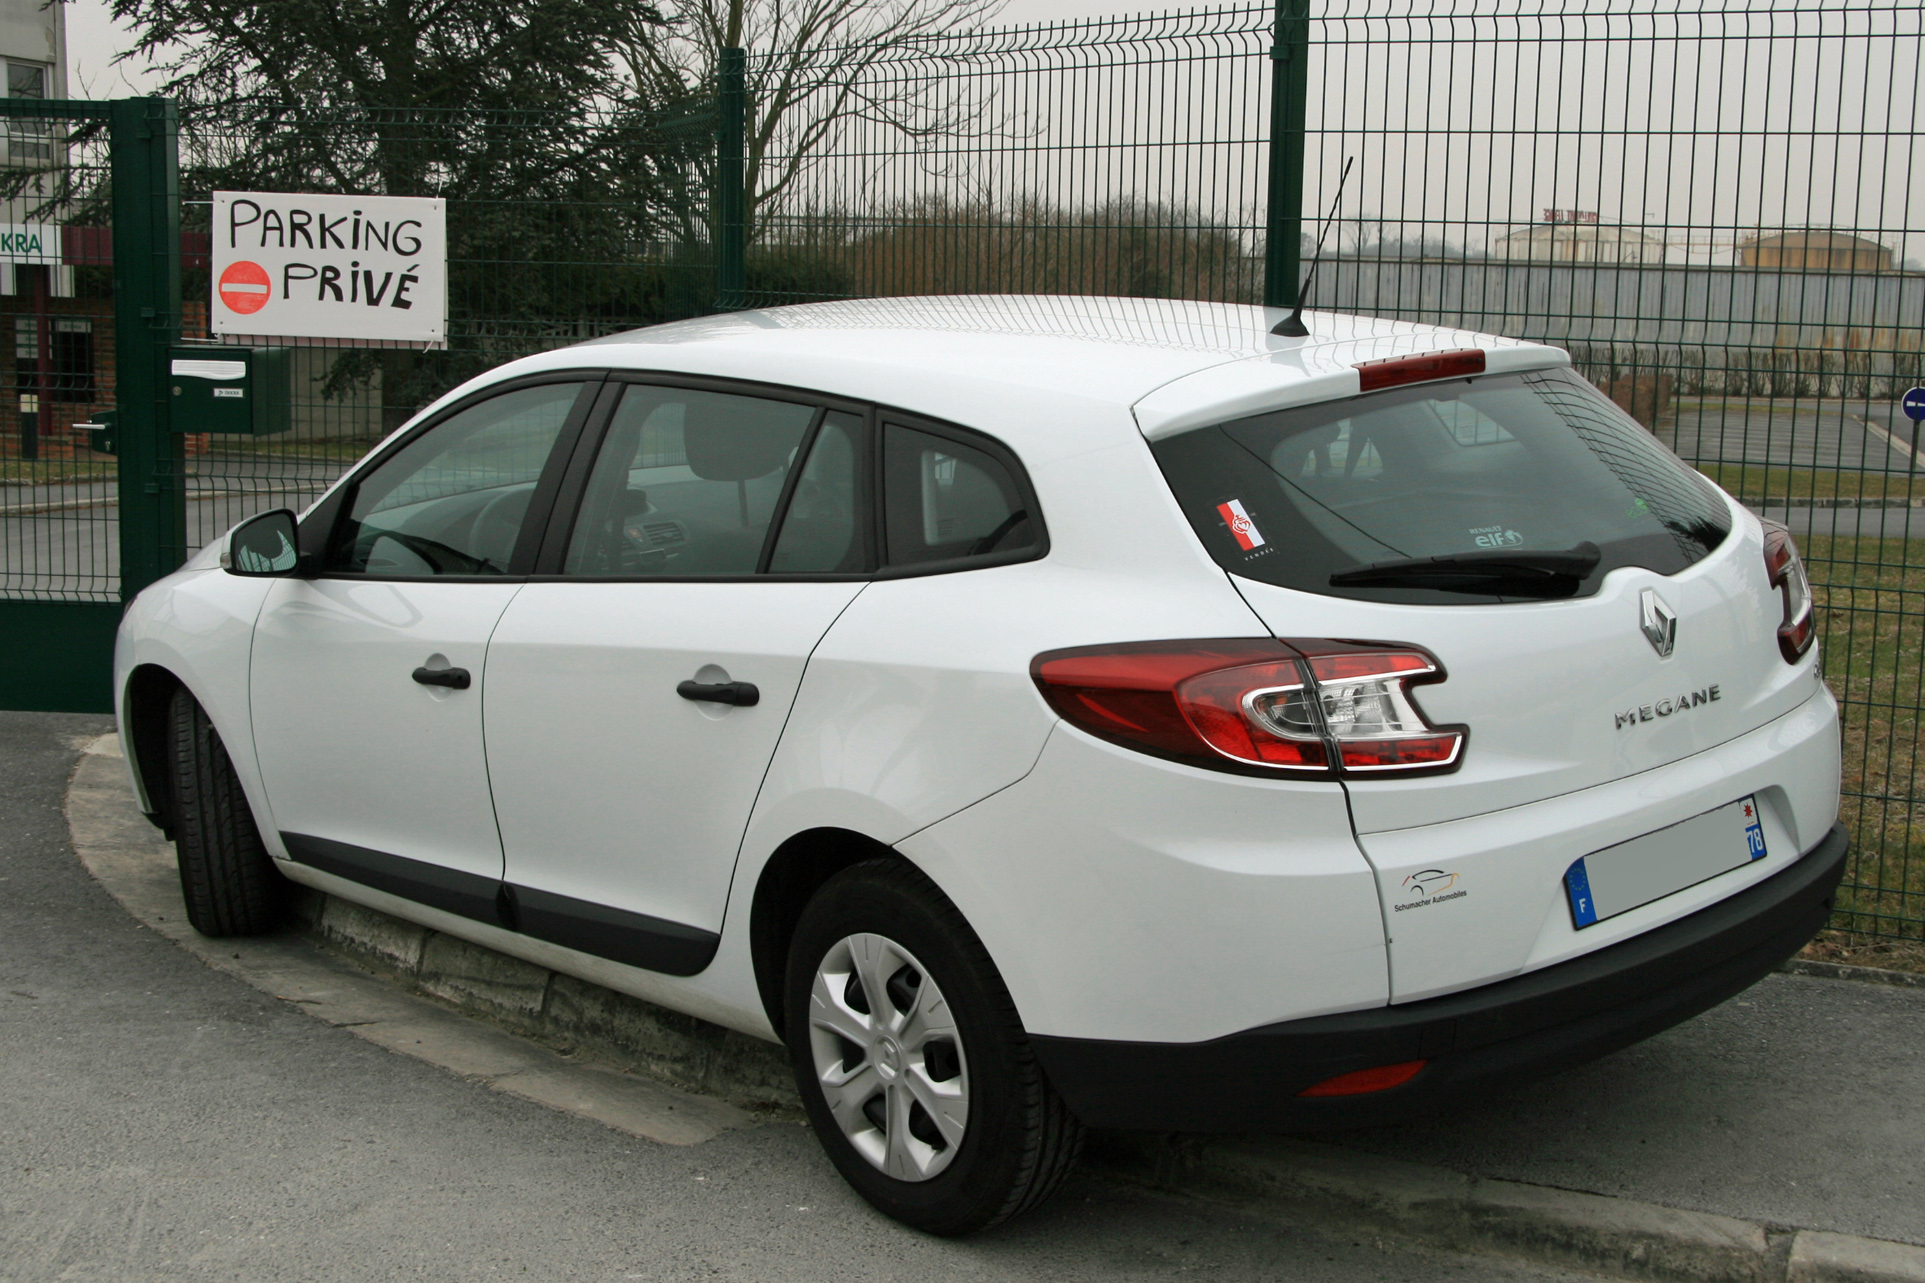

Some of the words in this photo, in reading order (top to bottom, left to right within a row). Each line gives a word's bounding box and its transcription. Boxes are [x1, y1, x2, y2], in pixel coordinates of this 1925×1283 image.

[1475, 533, 1504, 547] elf
[1614, 683, 1721, 730] MEGANE
[1747, 828, 1763, 853] 78
[1394, 898, 1432, 912] Schumacher
[1432, 890, 1467, 904] Automobiles
[1578, 898, 1586, 914] F
